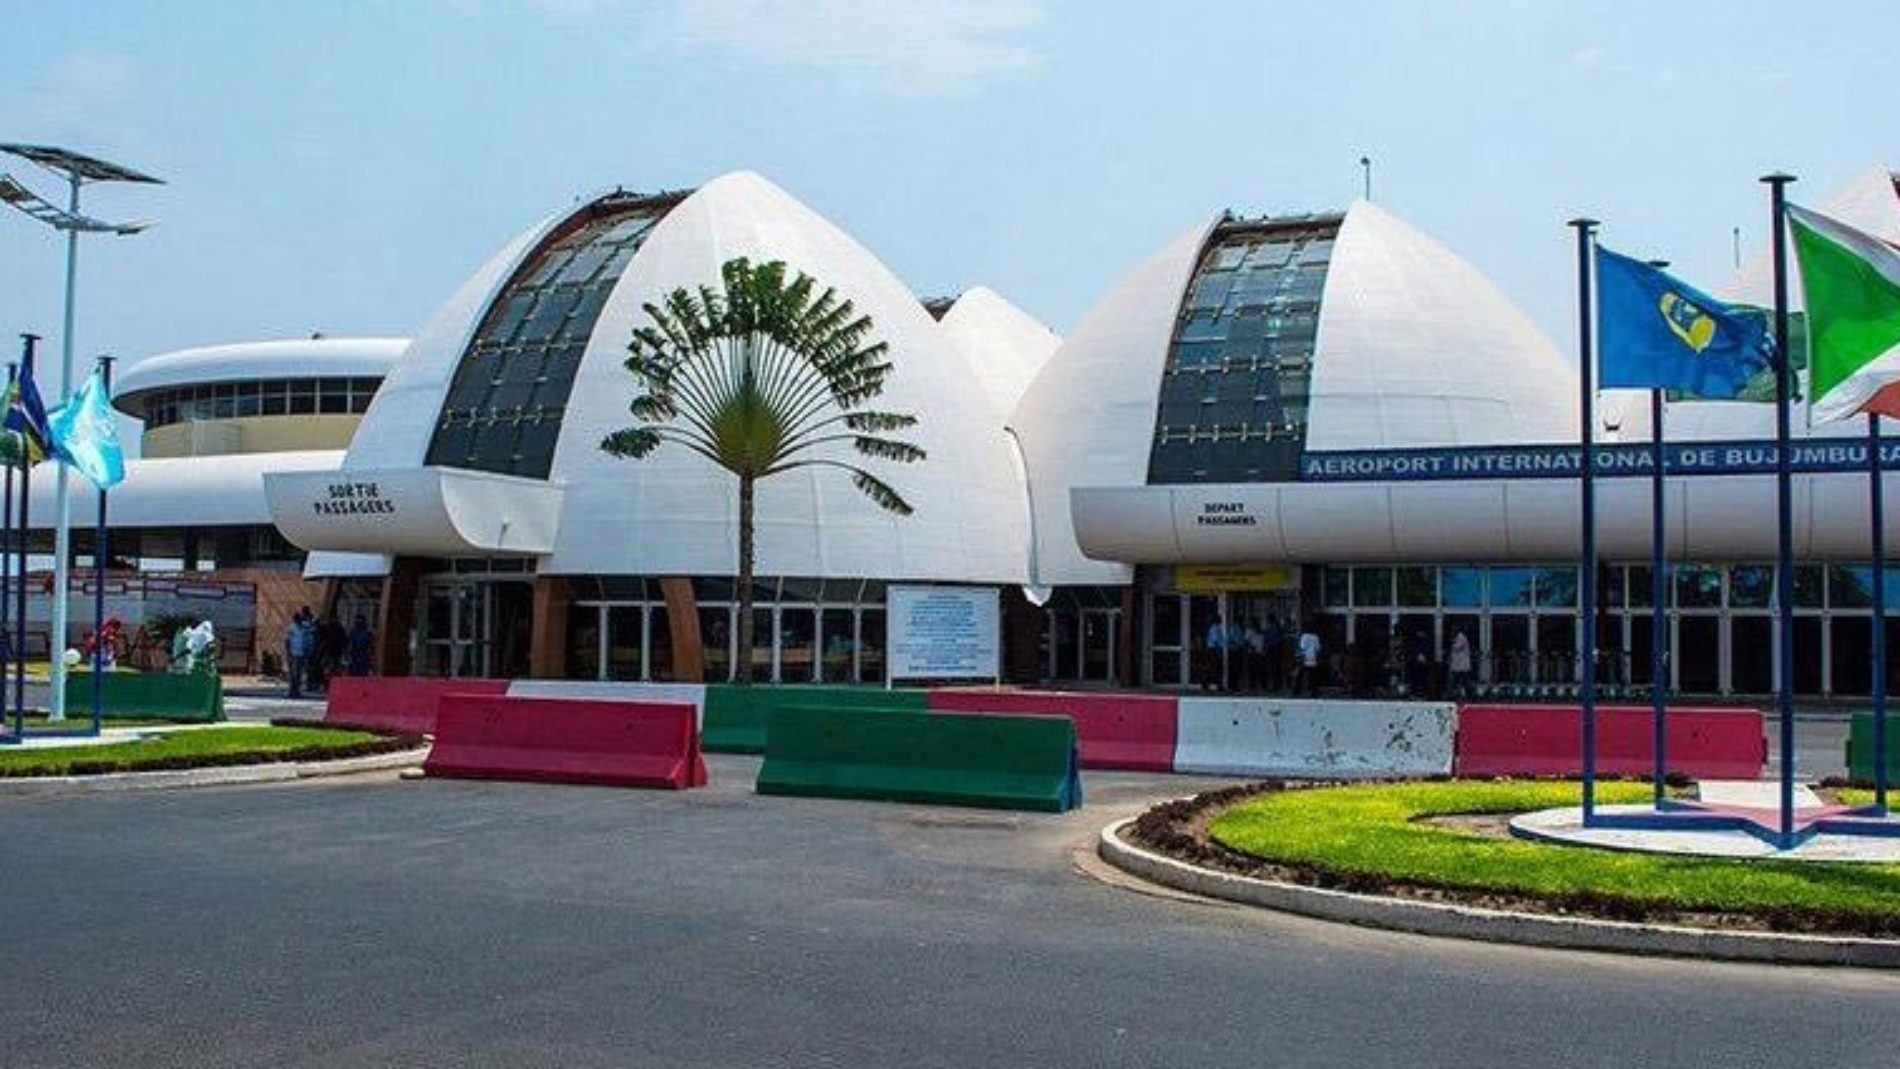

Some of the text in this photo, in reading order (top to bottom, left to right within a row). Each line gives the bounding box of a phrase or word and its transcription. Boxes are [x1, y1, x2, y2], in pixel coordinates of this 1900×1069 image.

[1308, 456, 1445, 474] AEROPORT
[1453, 451, 1672, 471] INTERNATONA
[1680, 450, 1715, 465] DE
[329, 483, 379, 498] SORTIE
[314, 500, 395, 514] PASSAGERS
